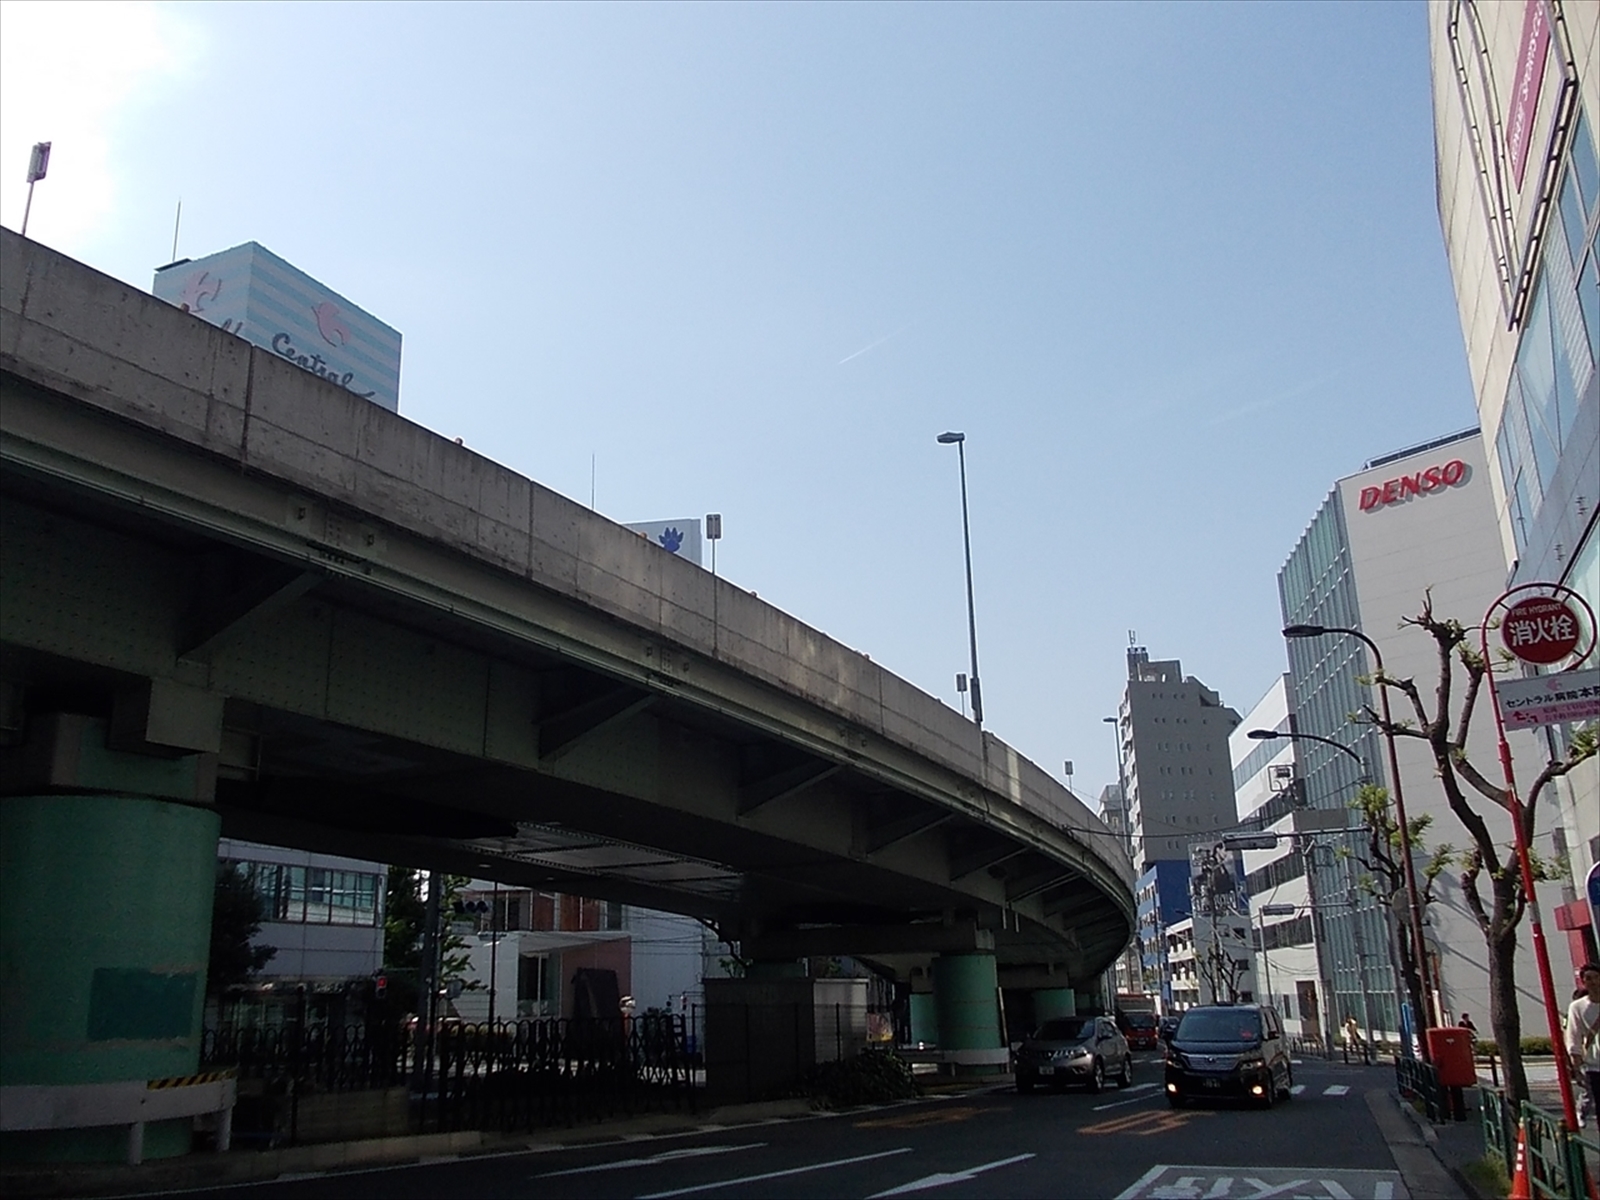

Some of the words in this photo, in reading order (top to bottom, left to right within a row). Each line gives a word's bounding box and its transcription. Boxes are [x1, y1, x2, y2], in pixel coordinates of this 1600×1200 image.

[272, 332, 375, 398] Central
[1359, 459, 1465, 511] DENSO
[1508, 613, 1575, 647] 消火栓
[1511, 606, 1527, 617] FIRE
[1528, 603, 1562, 615] HYDRANT
